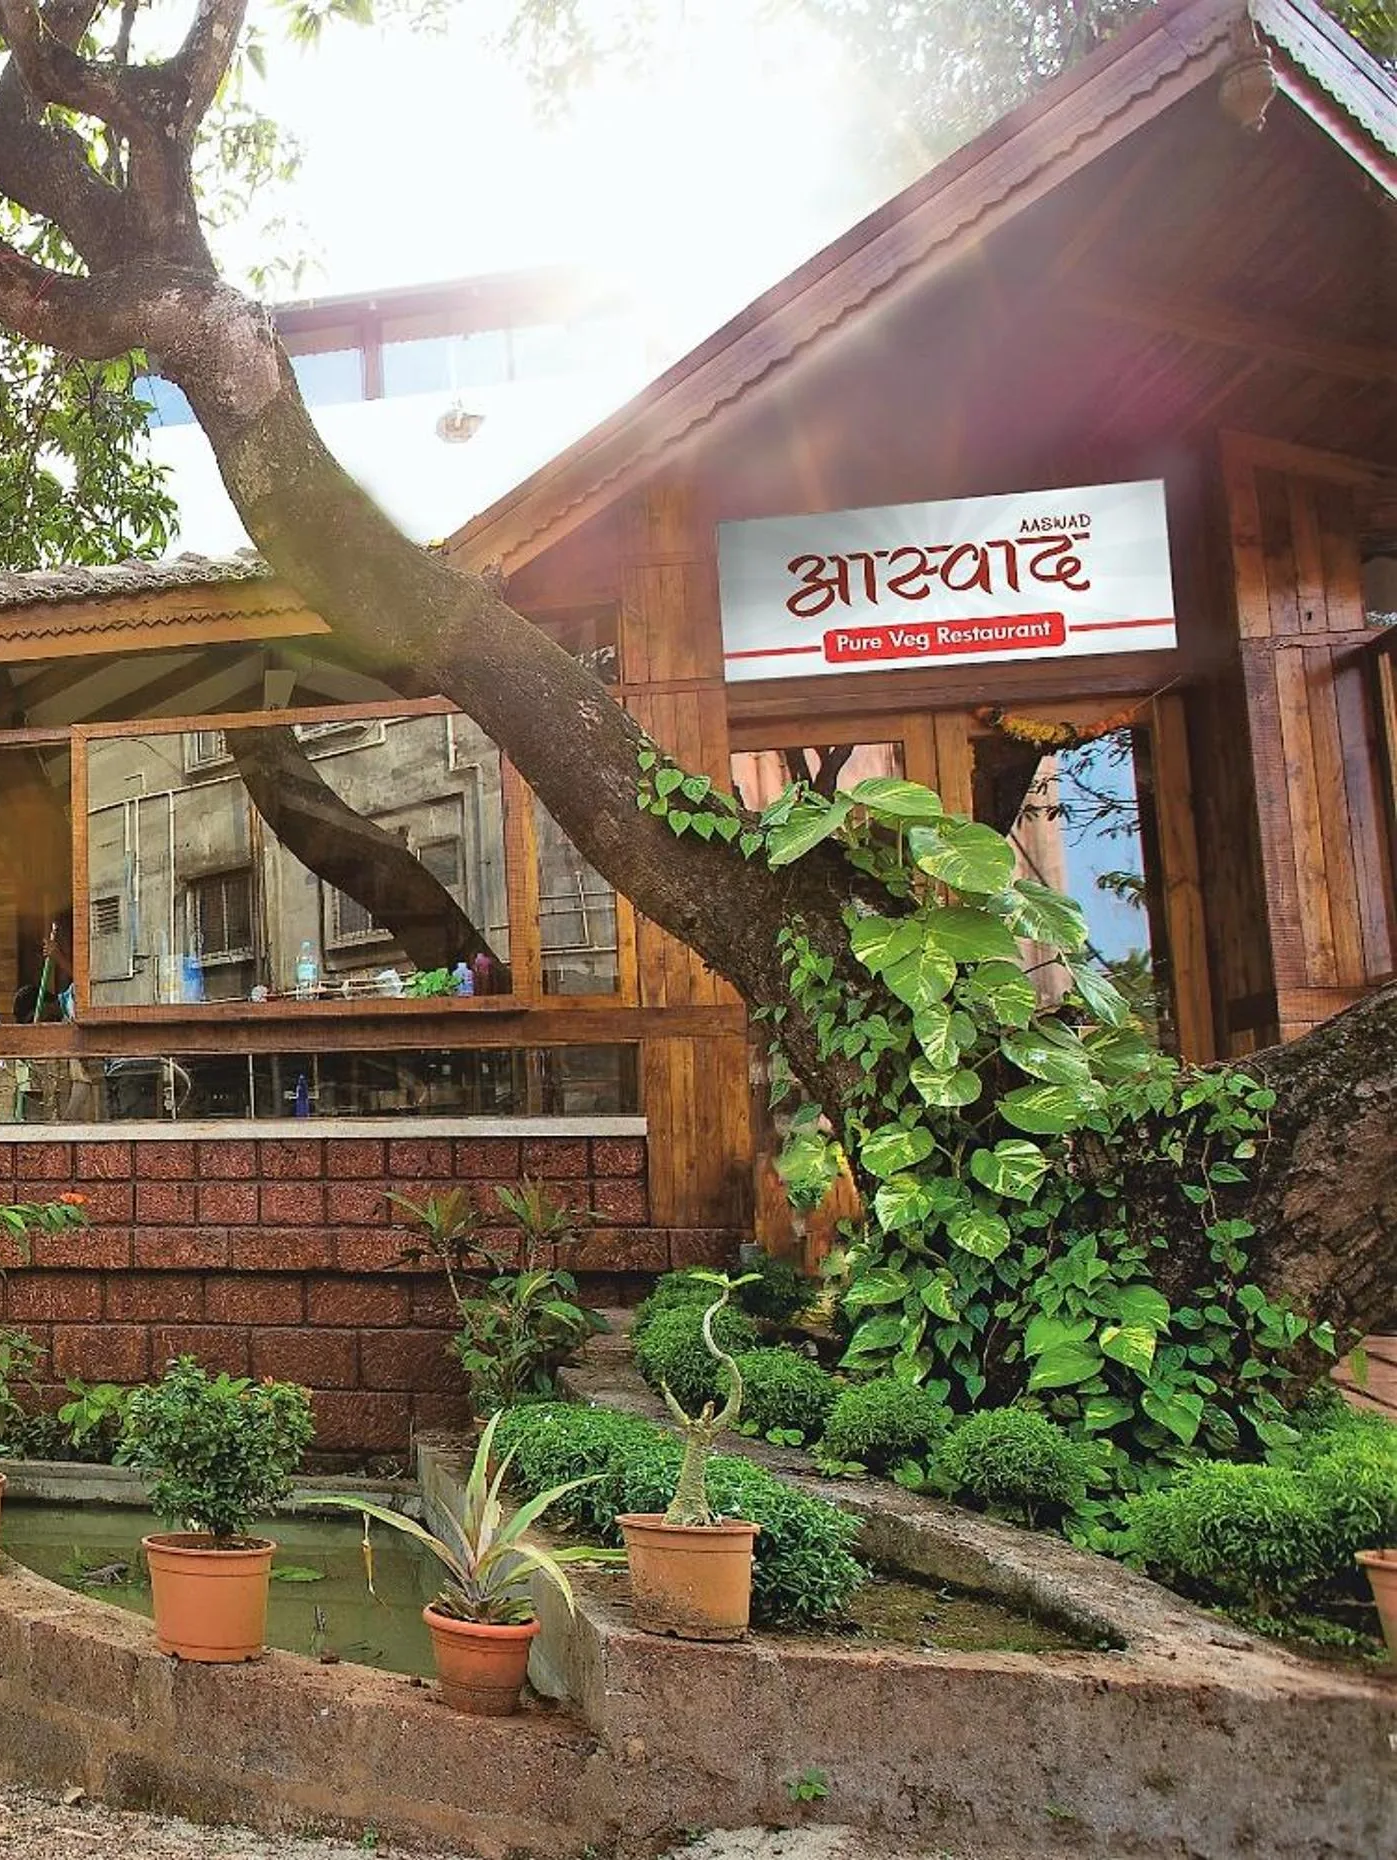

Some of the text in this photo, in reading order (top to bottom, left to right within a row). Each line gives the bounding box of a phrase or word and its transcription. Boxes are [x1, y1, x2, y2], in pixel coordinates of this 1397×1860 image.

[1019, 513, 1092, 533] AASWAD
[786, 532, 1091, 618] आस्वाद
[835, 621, 1052, 652] Pure Veg Restaurant
